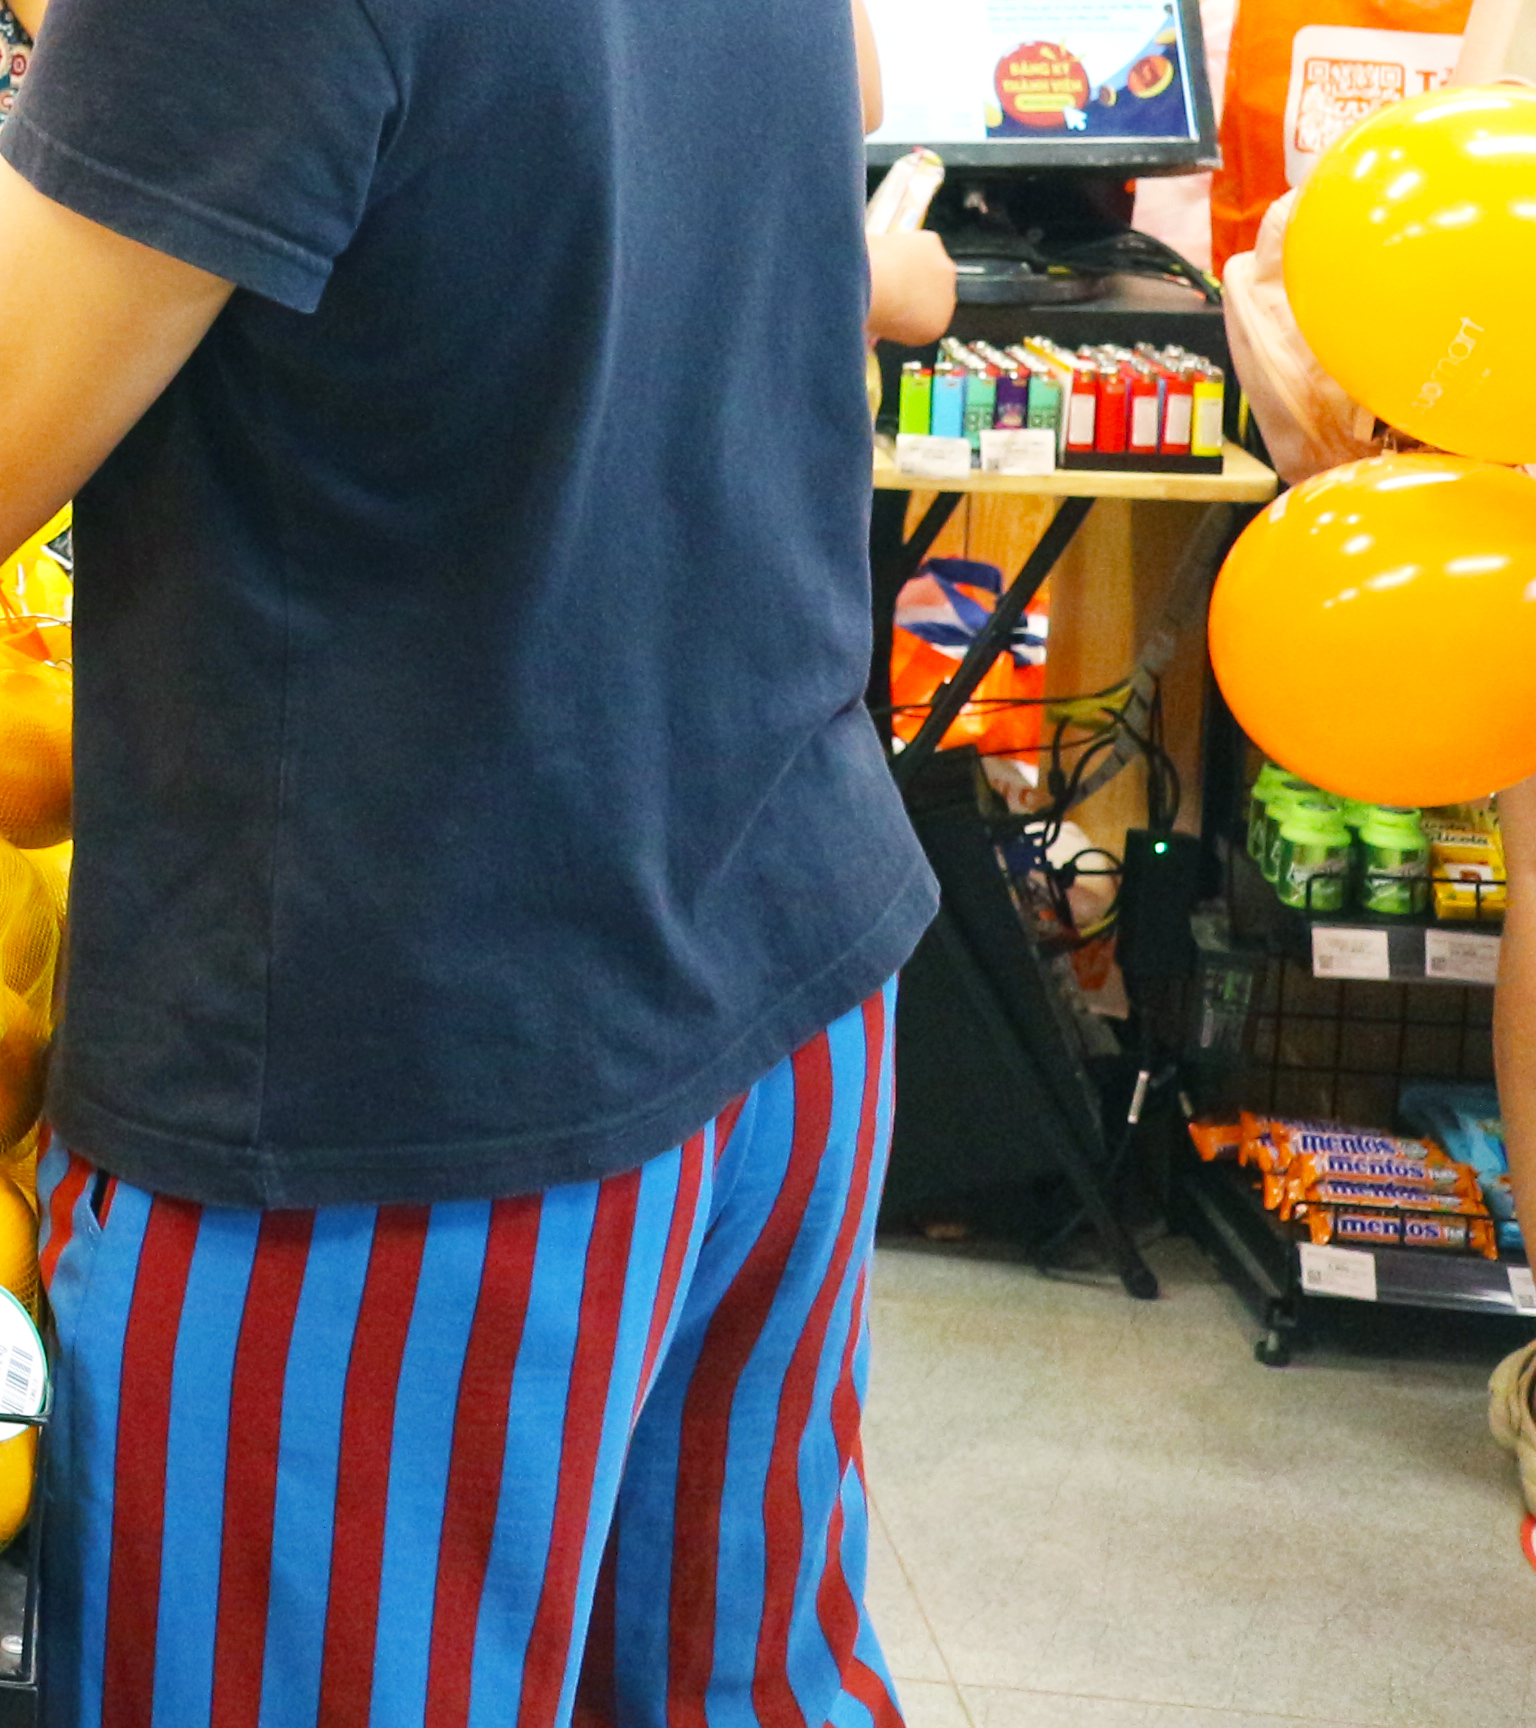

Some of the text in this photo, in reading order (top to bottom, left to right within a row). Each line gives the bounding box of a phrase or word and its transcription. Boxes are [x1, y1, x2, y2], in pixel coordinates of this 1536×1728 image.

[1300, 1133, 1396, 1155] mentos
[1328, 1154, 1425, 1179] mentos
[1339, 1218, 1440, 1239] menos
